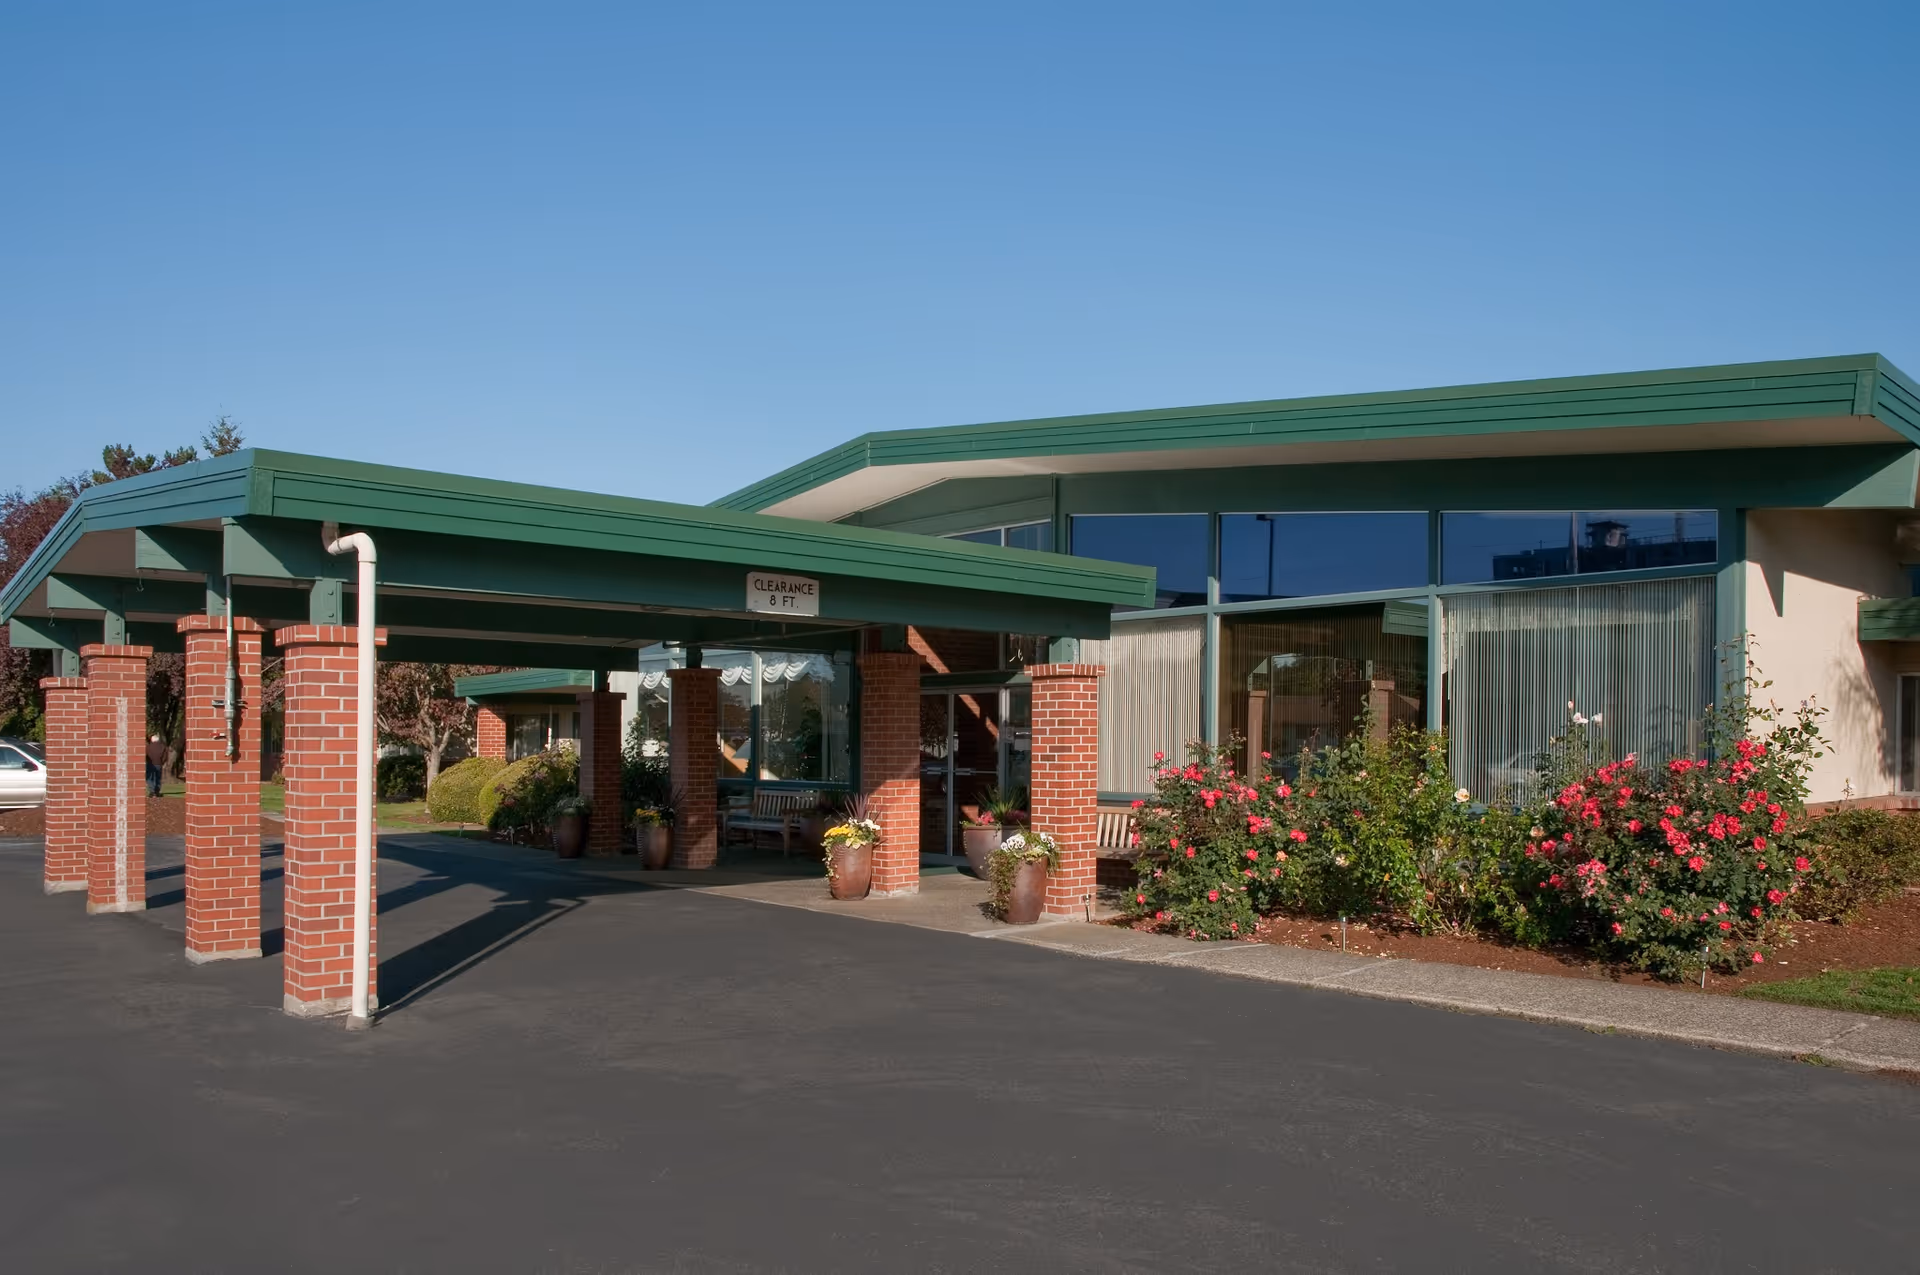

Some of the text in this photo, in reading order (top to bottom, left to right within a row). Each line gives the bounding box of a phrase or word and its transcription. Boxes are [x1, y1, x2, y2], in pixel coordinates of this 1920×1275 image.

[754, 579, 814, 595] CLEARANCE
[769, 594, 799, 609] 8 FT.
